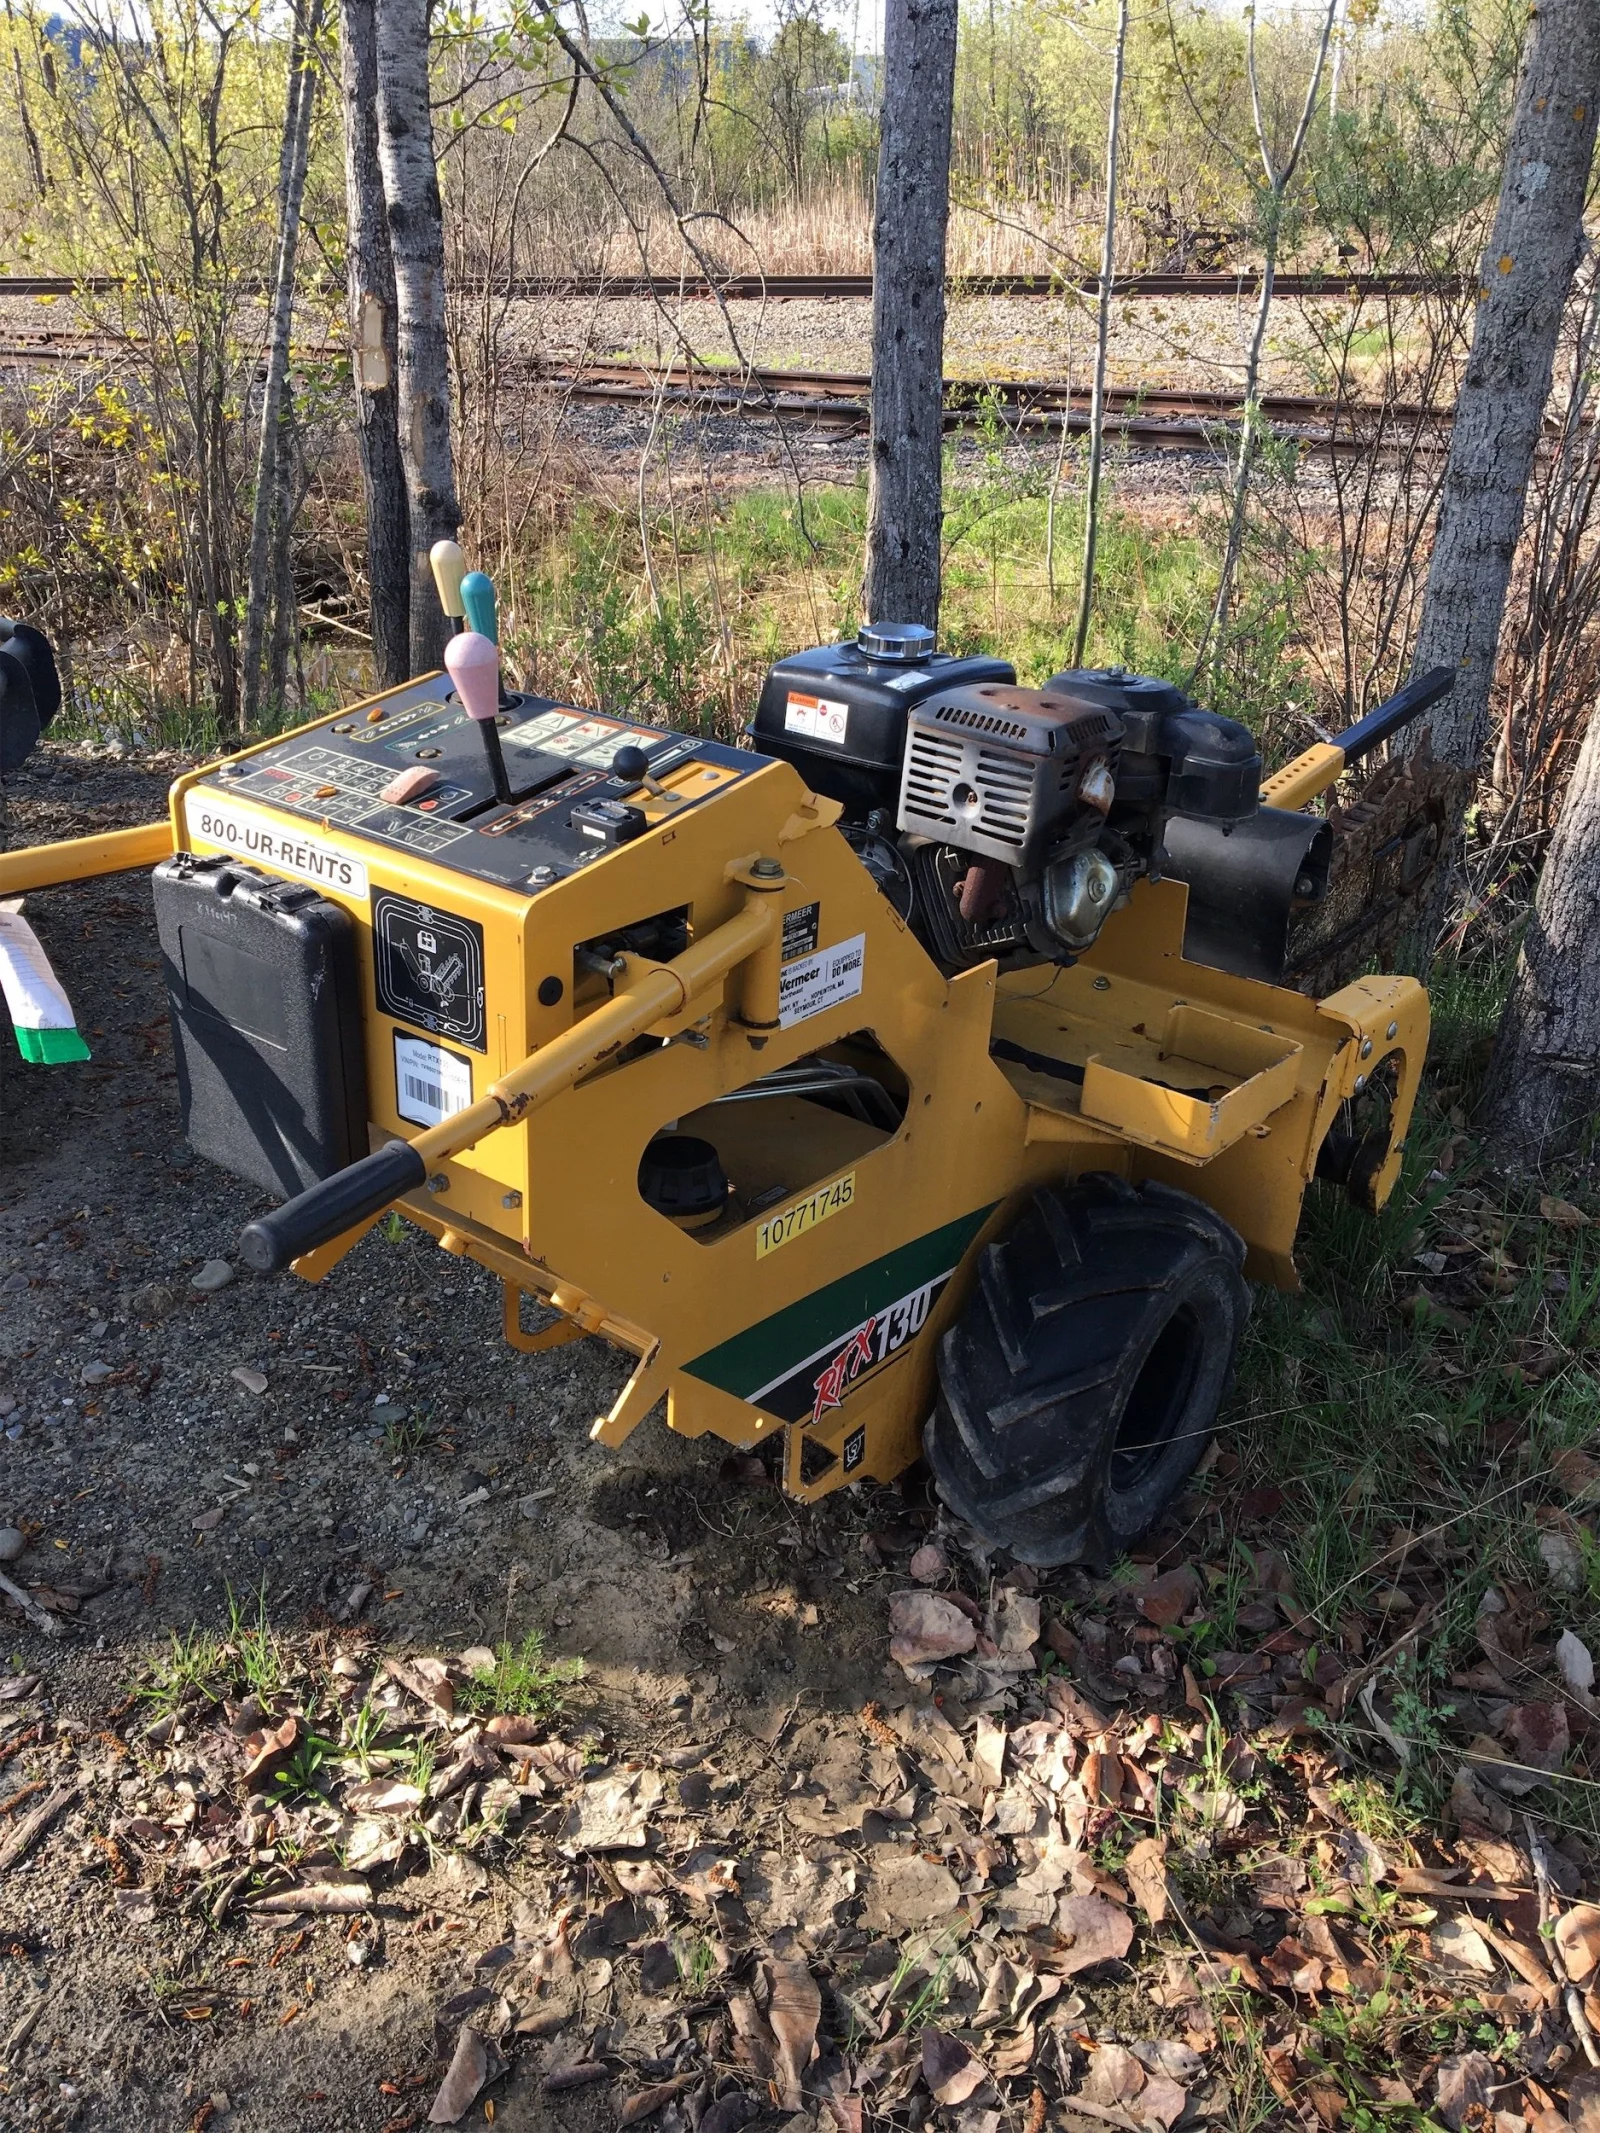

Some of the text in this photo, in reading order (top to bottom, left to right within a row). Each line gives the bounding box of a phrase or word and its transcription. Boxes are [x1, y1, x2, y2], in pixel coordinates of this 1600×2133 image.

[201, 814, 353, 885] 800-UR-RENTS
[782, 905, 813, 924] ERMEER
[832, 948, 862, 967] EQUIPPED TO
[832, 957, 862, 979] DO MORE.
[780, 967, 820, 993] Vermeer
[837, 979, 845, 989] MA
[780, 987, 804, 1001] Northeast
[762, 1178, 852, 1250] 10771745
